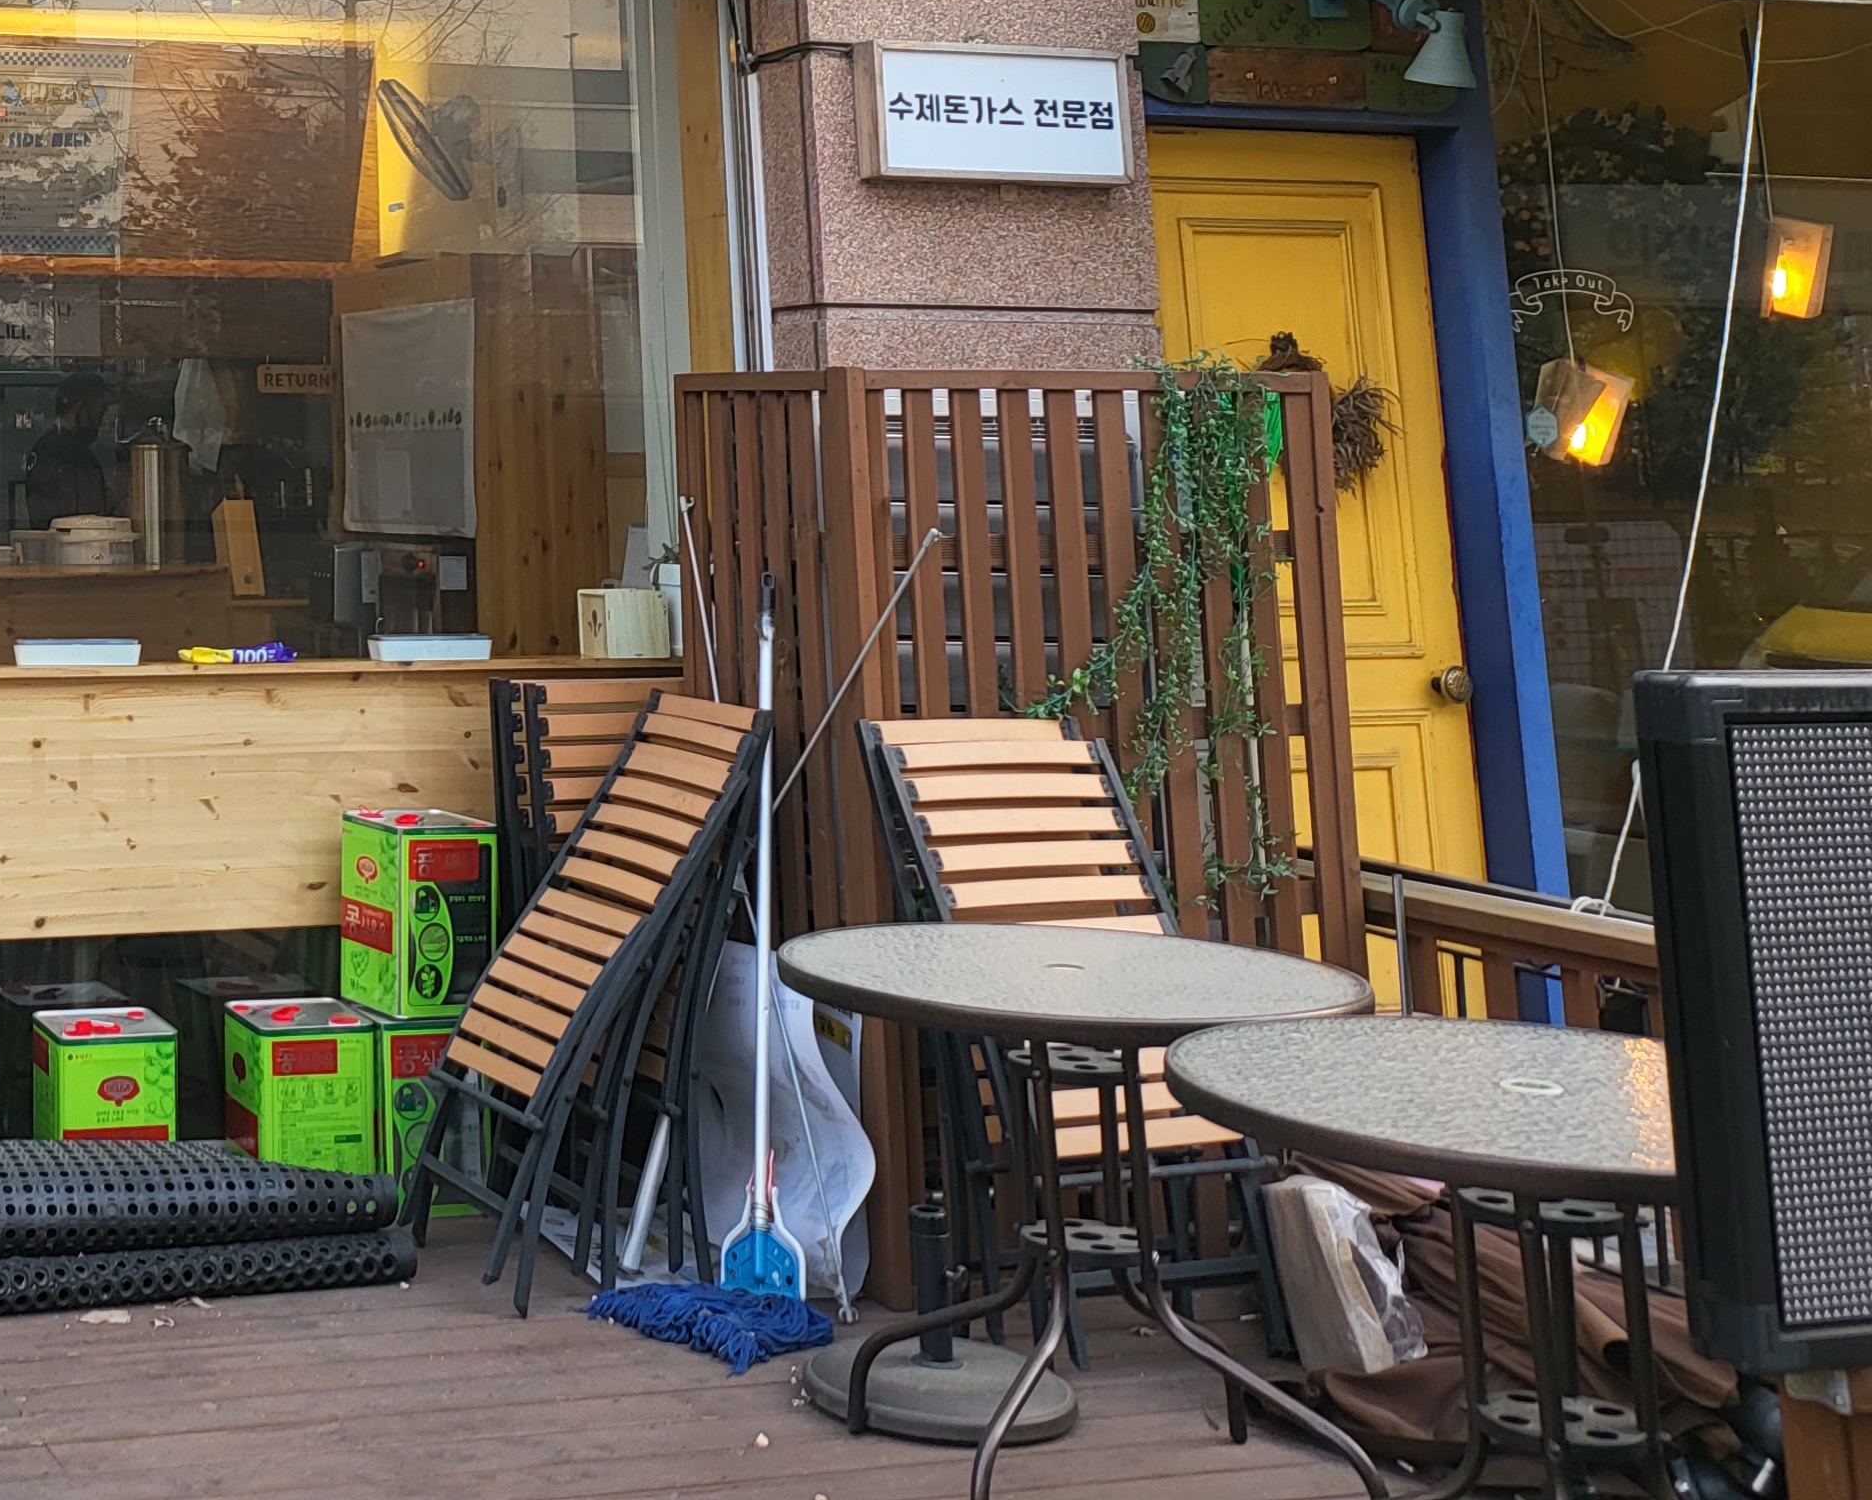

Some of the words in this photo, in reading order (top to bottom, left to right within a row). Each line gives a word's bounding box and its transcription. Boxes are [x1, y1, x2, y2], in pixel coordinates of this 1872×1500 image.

[888, 92, 1025, 126] 수제돈가스
[1034, 98, 1114, 130] 전문점
[1575, 275, 1603, 290] Out
